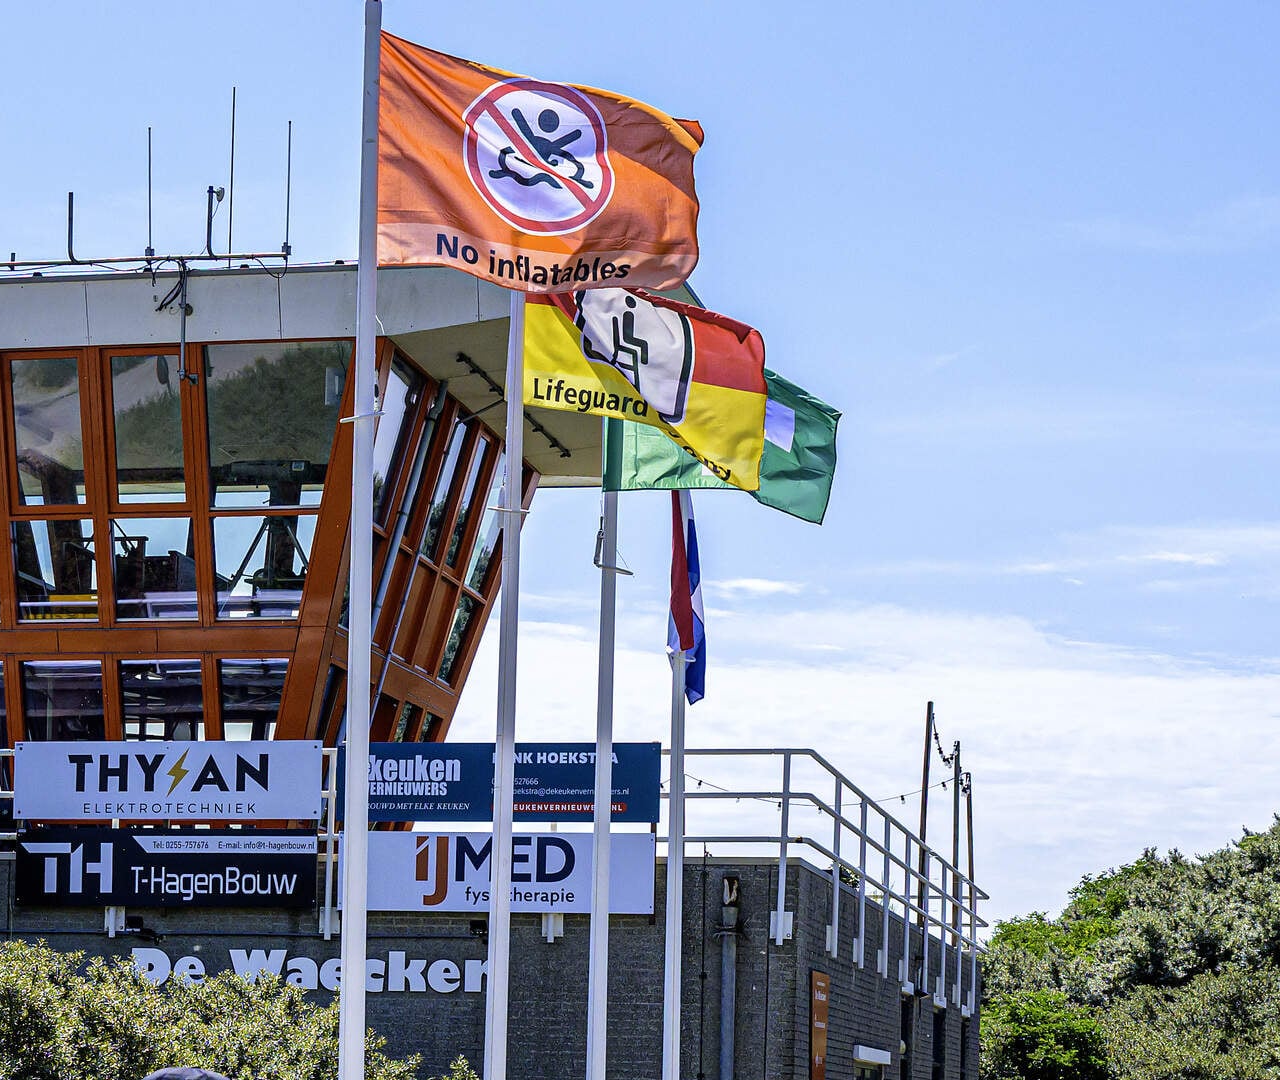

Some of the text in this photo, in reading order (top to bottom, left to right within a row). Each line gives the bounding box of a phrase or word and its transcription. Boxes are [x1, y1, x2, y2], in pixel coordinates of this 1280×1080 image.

[436, 233, 632, 286] No inflatables
[533, 377, 649, 417] Lifeguard
[536, 752, 619, 764] HOEKSTA
[83, 803, 256, 814] ELEKTROTECHNIEK
[397, 802, 413, 810] MET
[414, 802, 435, 810] ELKE
[437, 802, 470, 810] KEUKEN
[153, 841, 315, 851] Tel: 0255-757676 E-mail: info@t-hagenbouw.nl
[131, 866, 297, 900] T-HagenBouw
[131, 947, 206, 986] De
